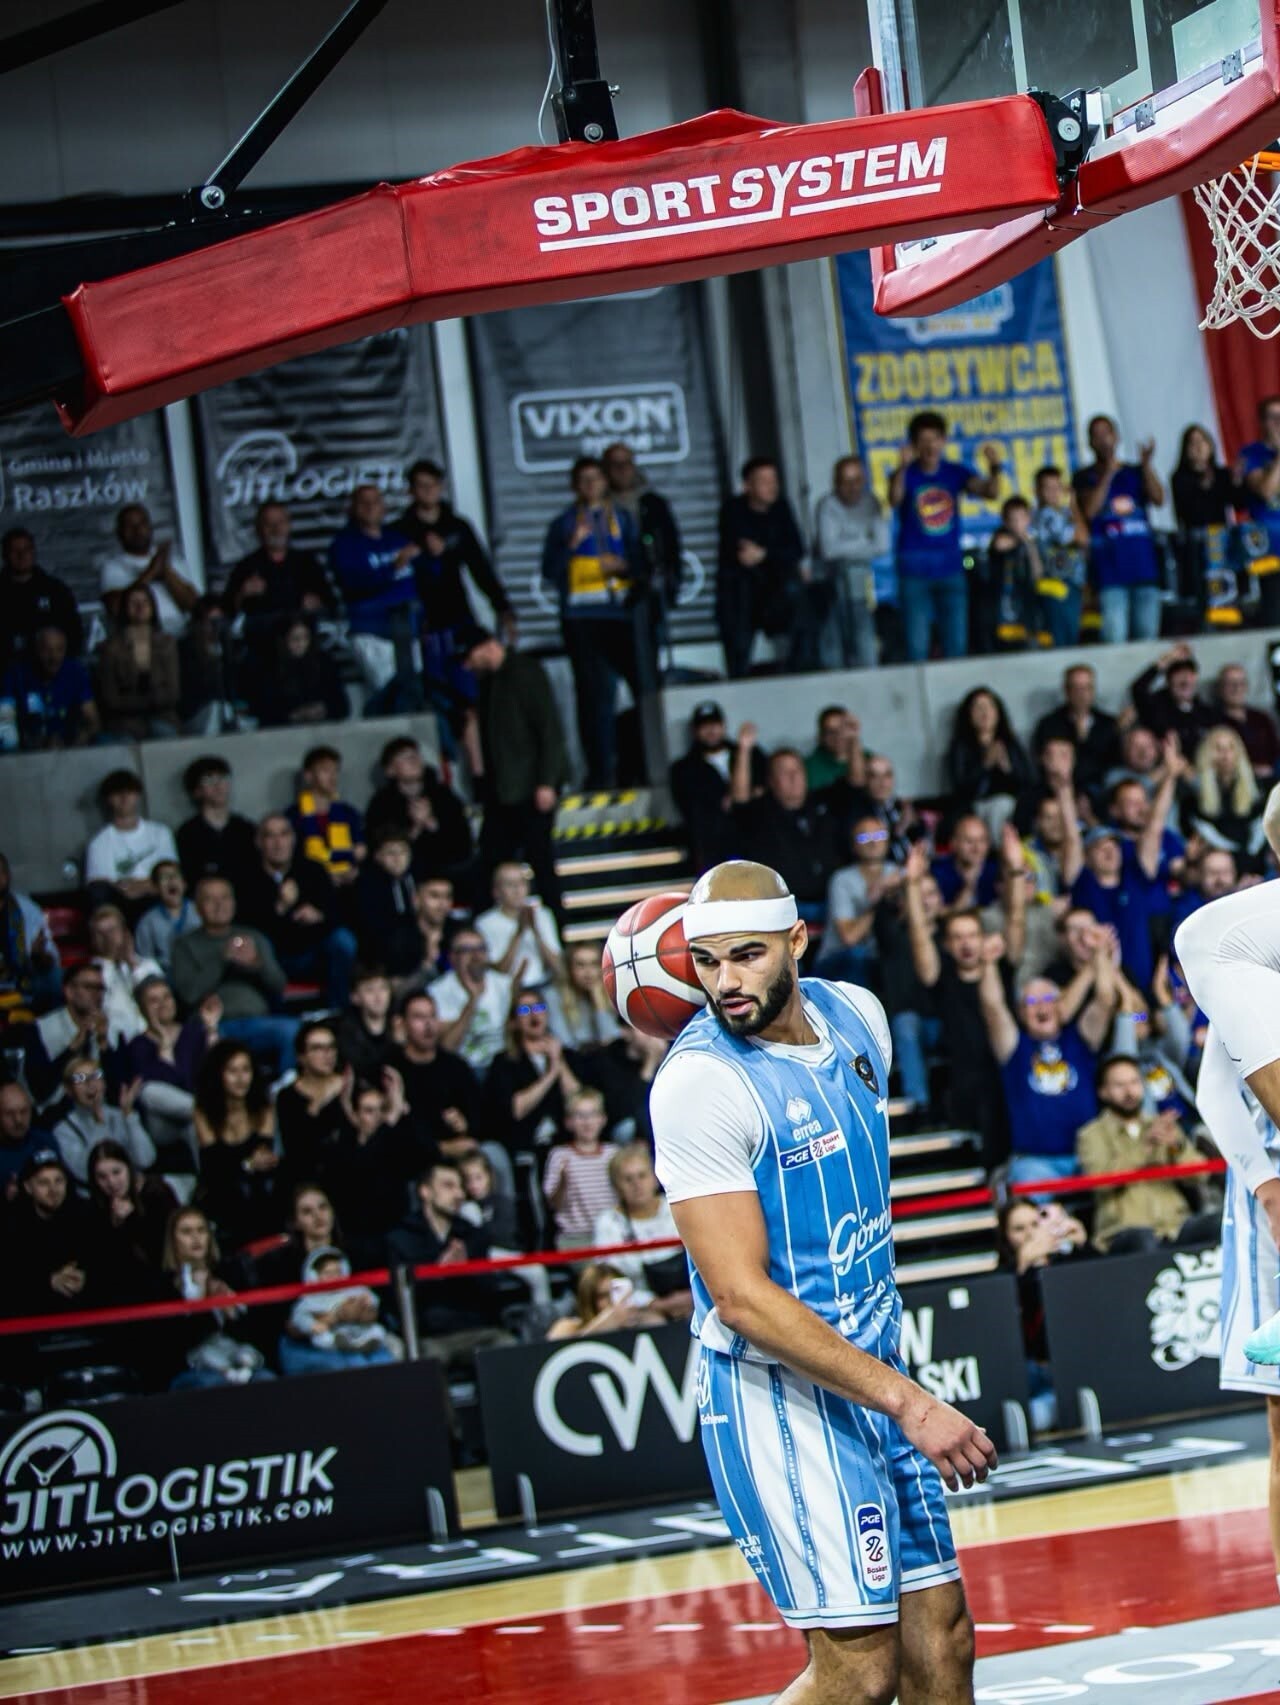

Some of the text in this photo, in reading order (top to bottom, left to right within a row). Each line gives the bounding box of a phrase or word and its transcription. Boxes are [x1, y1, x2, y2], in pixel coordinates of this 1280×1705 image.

[534, 136, 948, 236] SPORT SYSTEM
[854, 340, 1063, 405] ZDOBYWCA
[522, 397, 673, 438] VIXON
[13, 471, 149, 512] Raszków
[785, 1149, 810, 1167] PGE
[0, 1446, 339, 1536] JITLOGISTIK
[2, 1496, 335, 1560] WWW.JITLOGISTIK.COM
[860, 1514, 881, 1526] PGE
